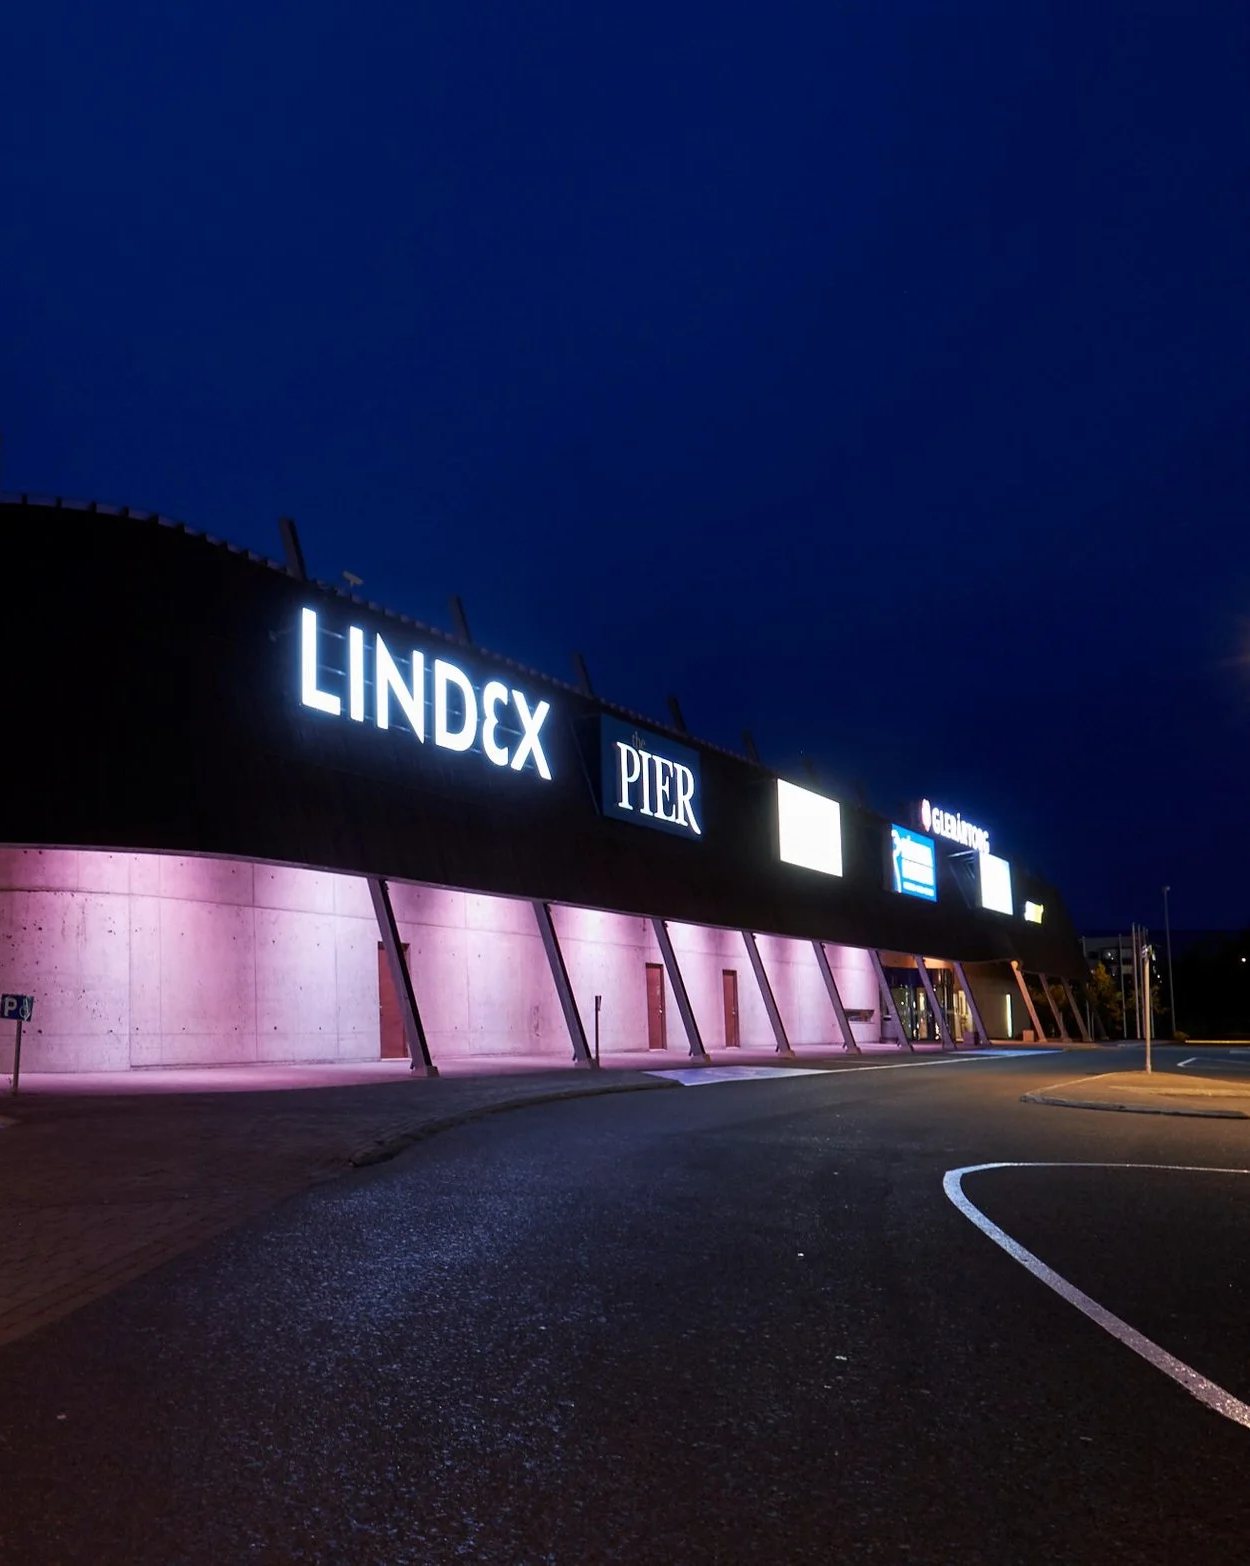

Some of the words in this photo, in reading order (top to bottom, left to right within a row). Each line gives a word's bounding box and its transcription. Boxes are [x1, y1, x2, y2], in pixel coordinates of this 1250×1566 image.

[302, 607, 553, 781] LINDEX
[632, 730, 646, 749] the
[616, 741, 702, 835] PIER
[4, 996, 17, 1016] P
